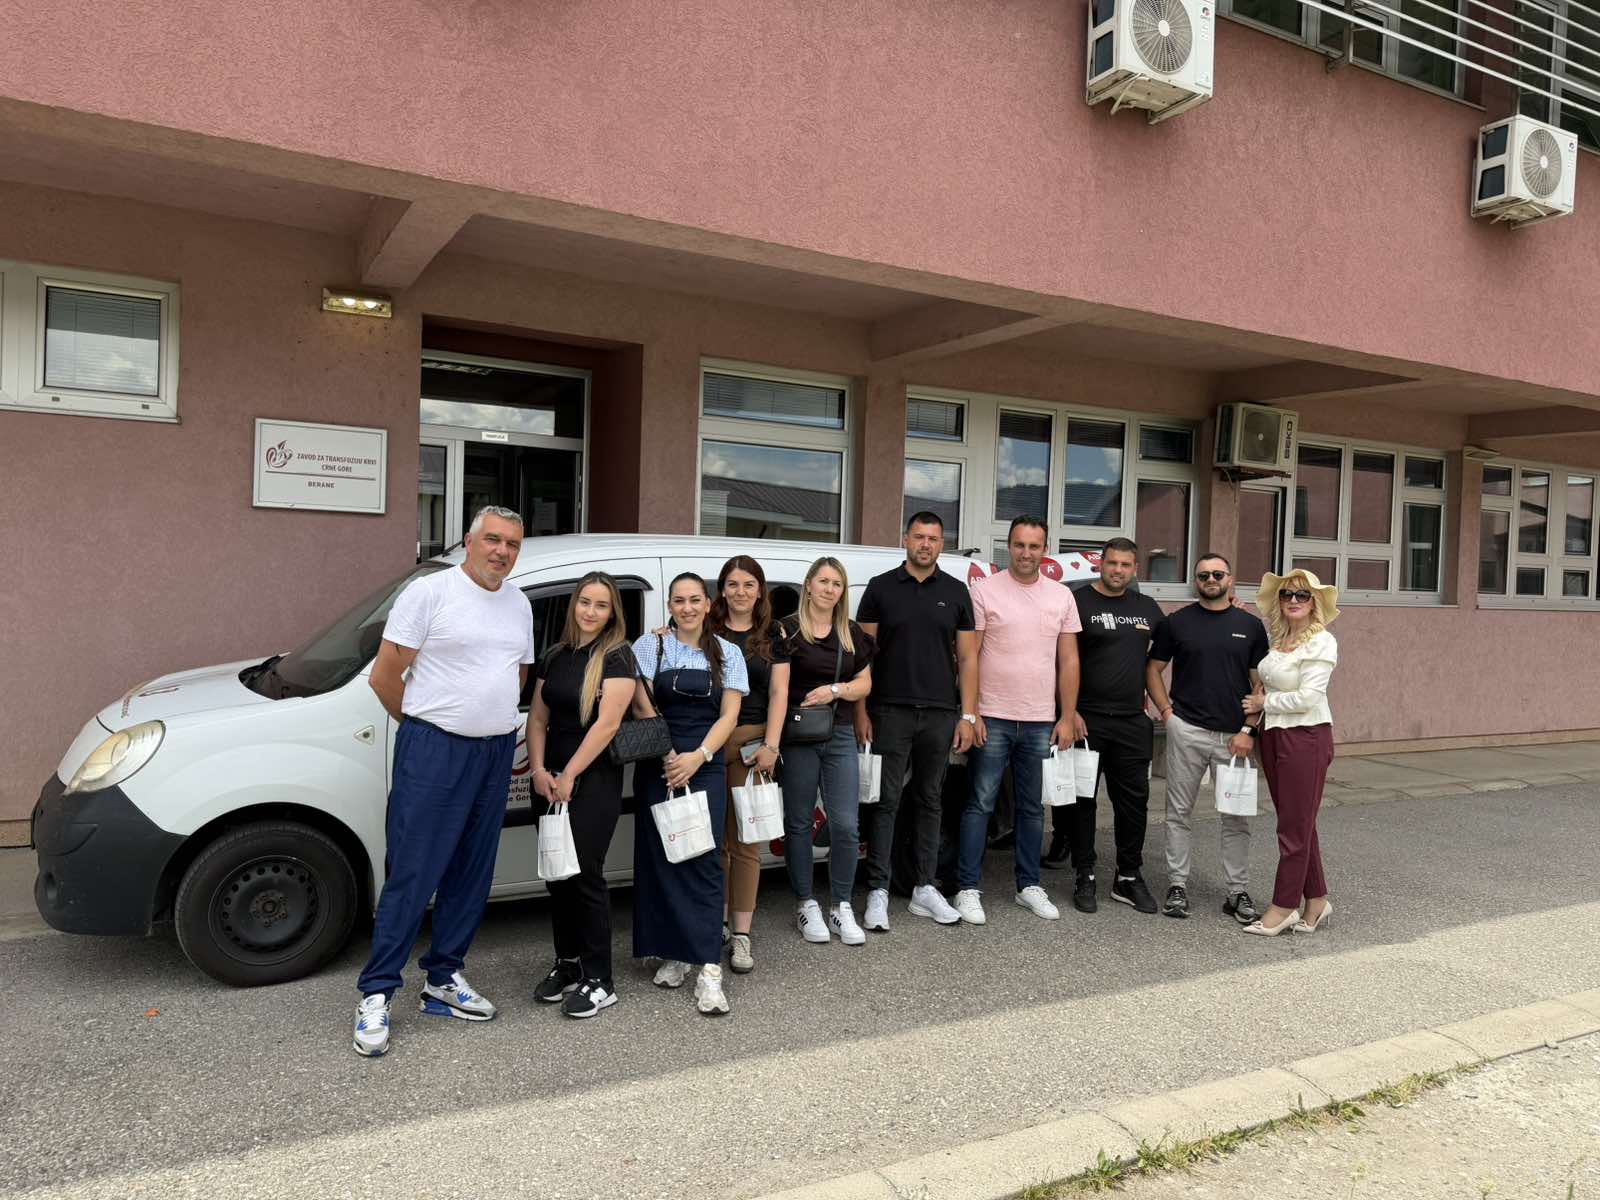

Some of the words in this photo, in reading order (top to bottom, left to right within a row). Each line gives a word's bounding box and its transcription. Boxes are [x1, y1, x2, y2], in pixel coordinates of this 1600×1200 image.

[1284, 420, 1293, 459] BEKO
[321, 464, 337, 472] CRNE
[337, 465, 353, 473] GORE
